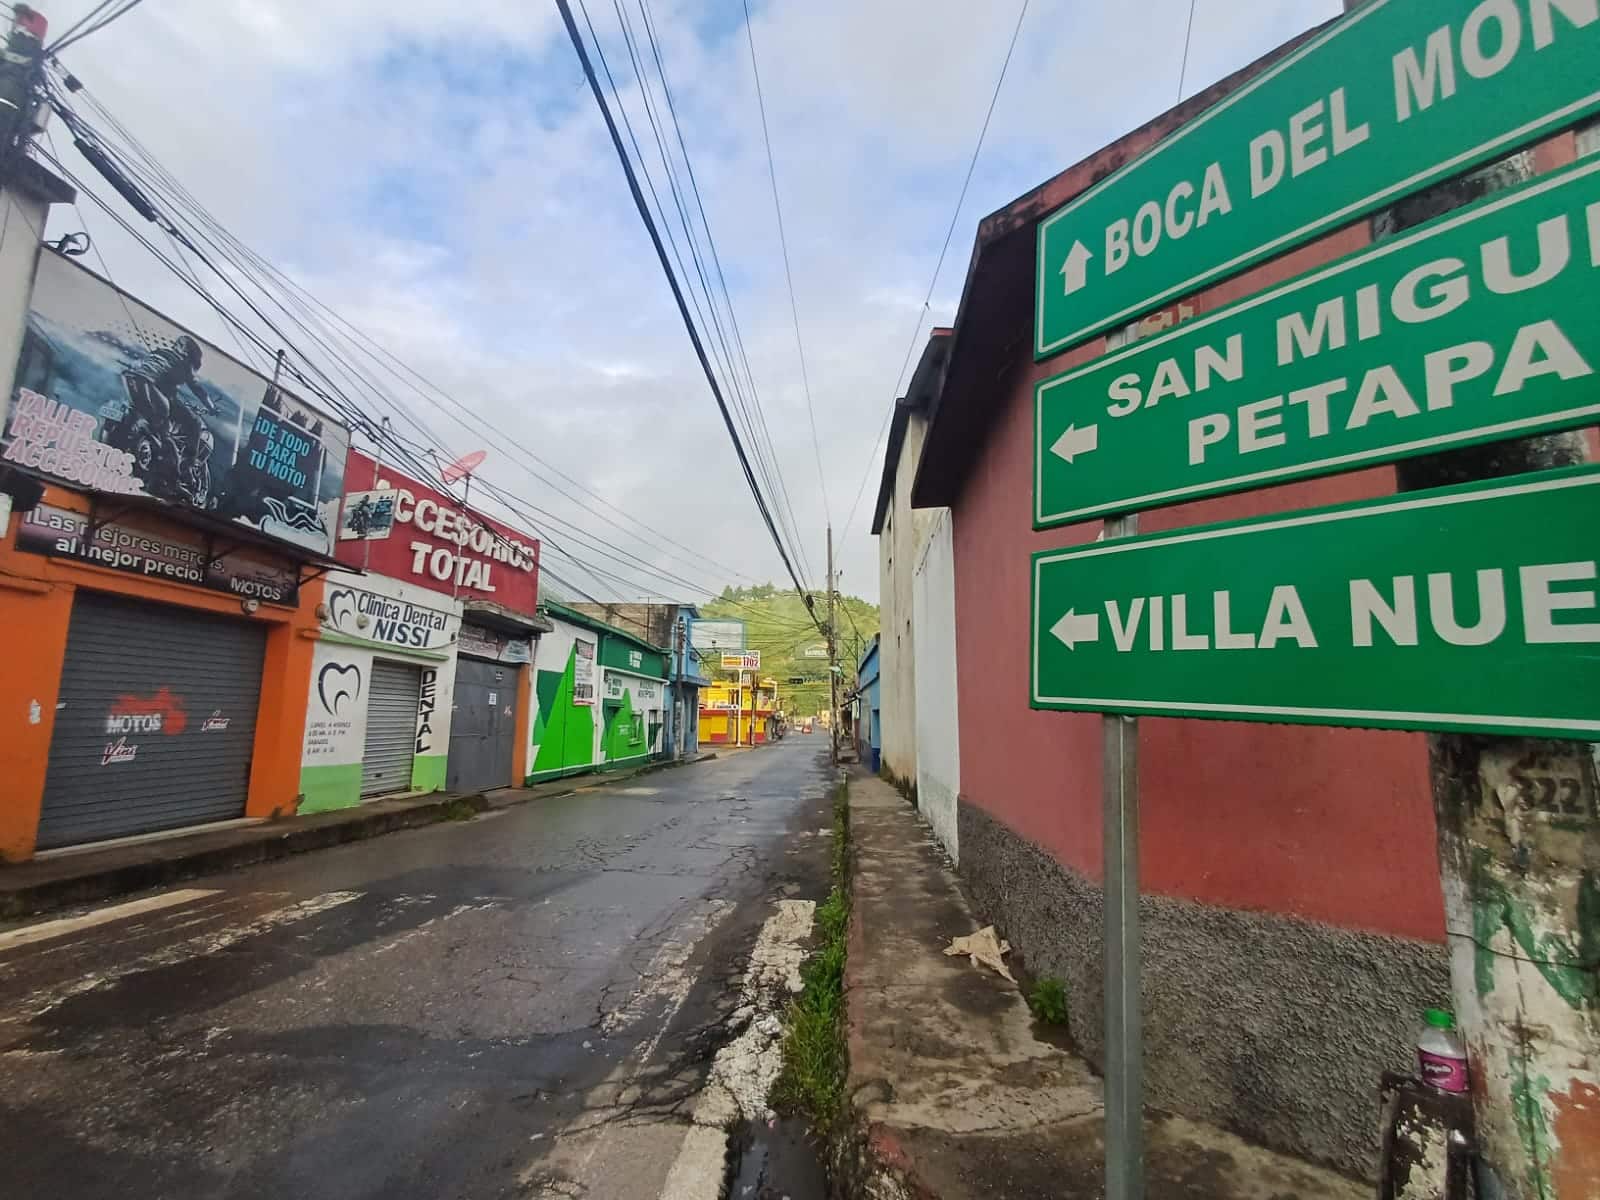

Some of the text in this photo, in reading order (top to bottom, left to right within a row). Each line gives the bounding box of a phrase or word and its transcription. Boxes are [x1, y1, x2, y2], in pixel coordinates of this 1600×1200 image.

[1104, 162, 1233, 276] BOCA
[1249, 87, 1371, 199] DEL
[1106, 333, 1244, 418] SAN
[1188, 319, 1594, 466] PETAPA
[18, 387, 98, 440] TALLER
[255, 416, 311, 457] ¡DE TODO
[249, 449, 307, 489] TU MOTO!
[264, 438, 297, 468] PARA
[55, 537, 204, 583] al mejor precio!
[410, 541, 496, 592] TOTAL
[230, 576, 281, 601] MOTOS
[1103, 560, 1600, 653] VILLA NUE
[372, 618, 431, 648] NISSI
[402, 605, 448, 631] Dental
[106, 713, 162, 734] MOTOS
[415, 669, 437, 755] DENTAL
